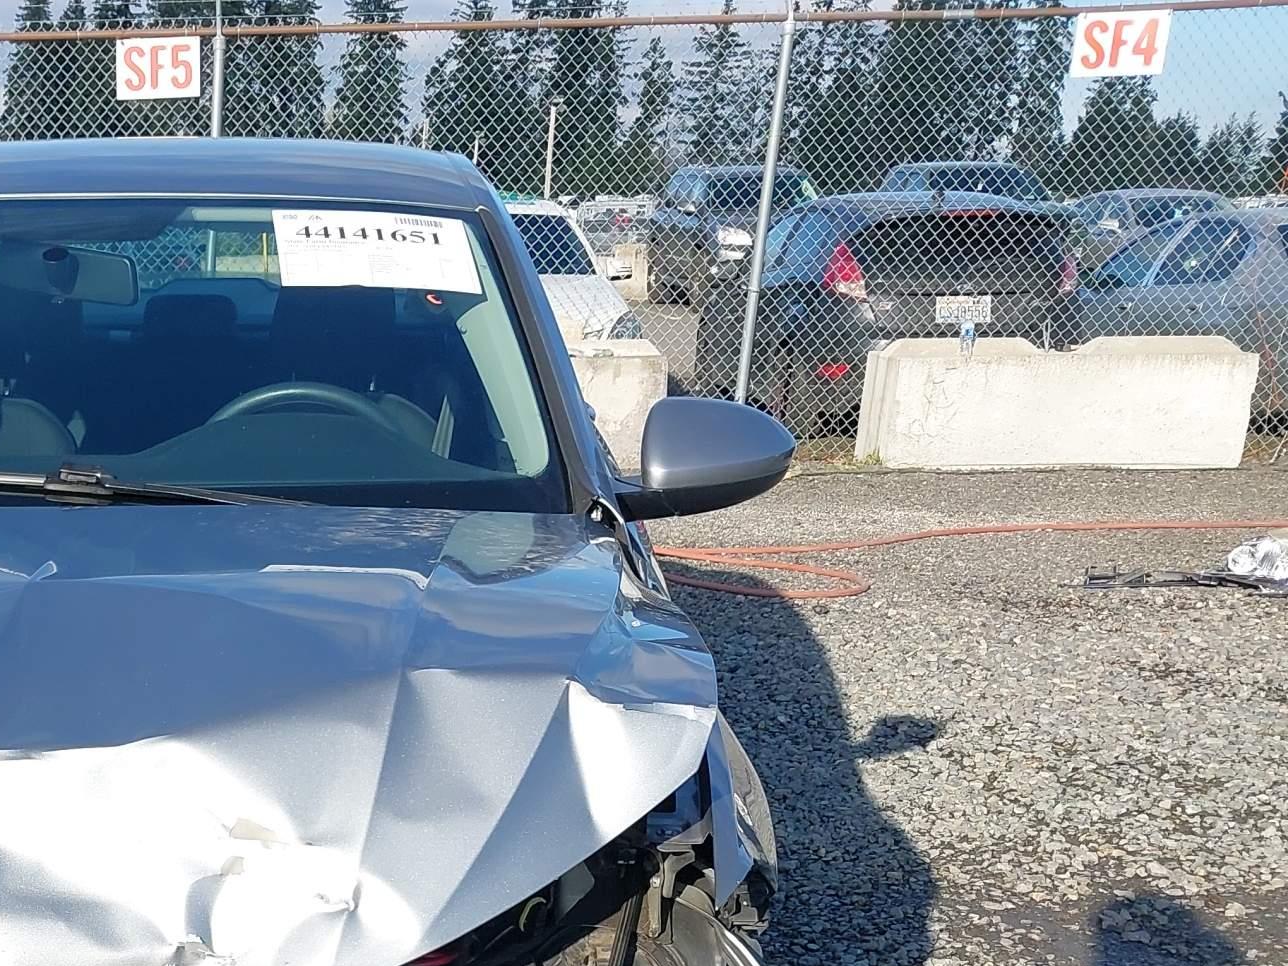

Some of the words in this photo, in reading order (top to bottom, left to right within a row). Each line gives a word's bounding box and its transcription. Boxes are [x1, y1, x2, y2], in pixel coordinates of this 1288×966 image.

[1081, 18, 1159, 69] SF4
[124, 45, 192, 91] SF5
[295, 225, 443, 245] 44141651
